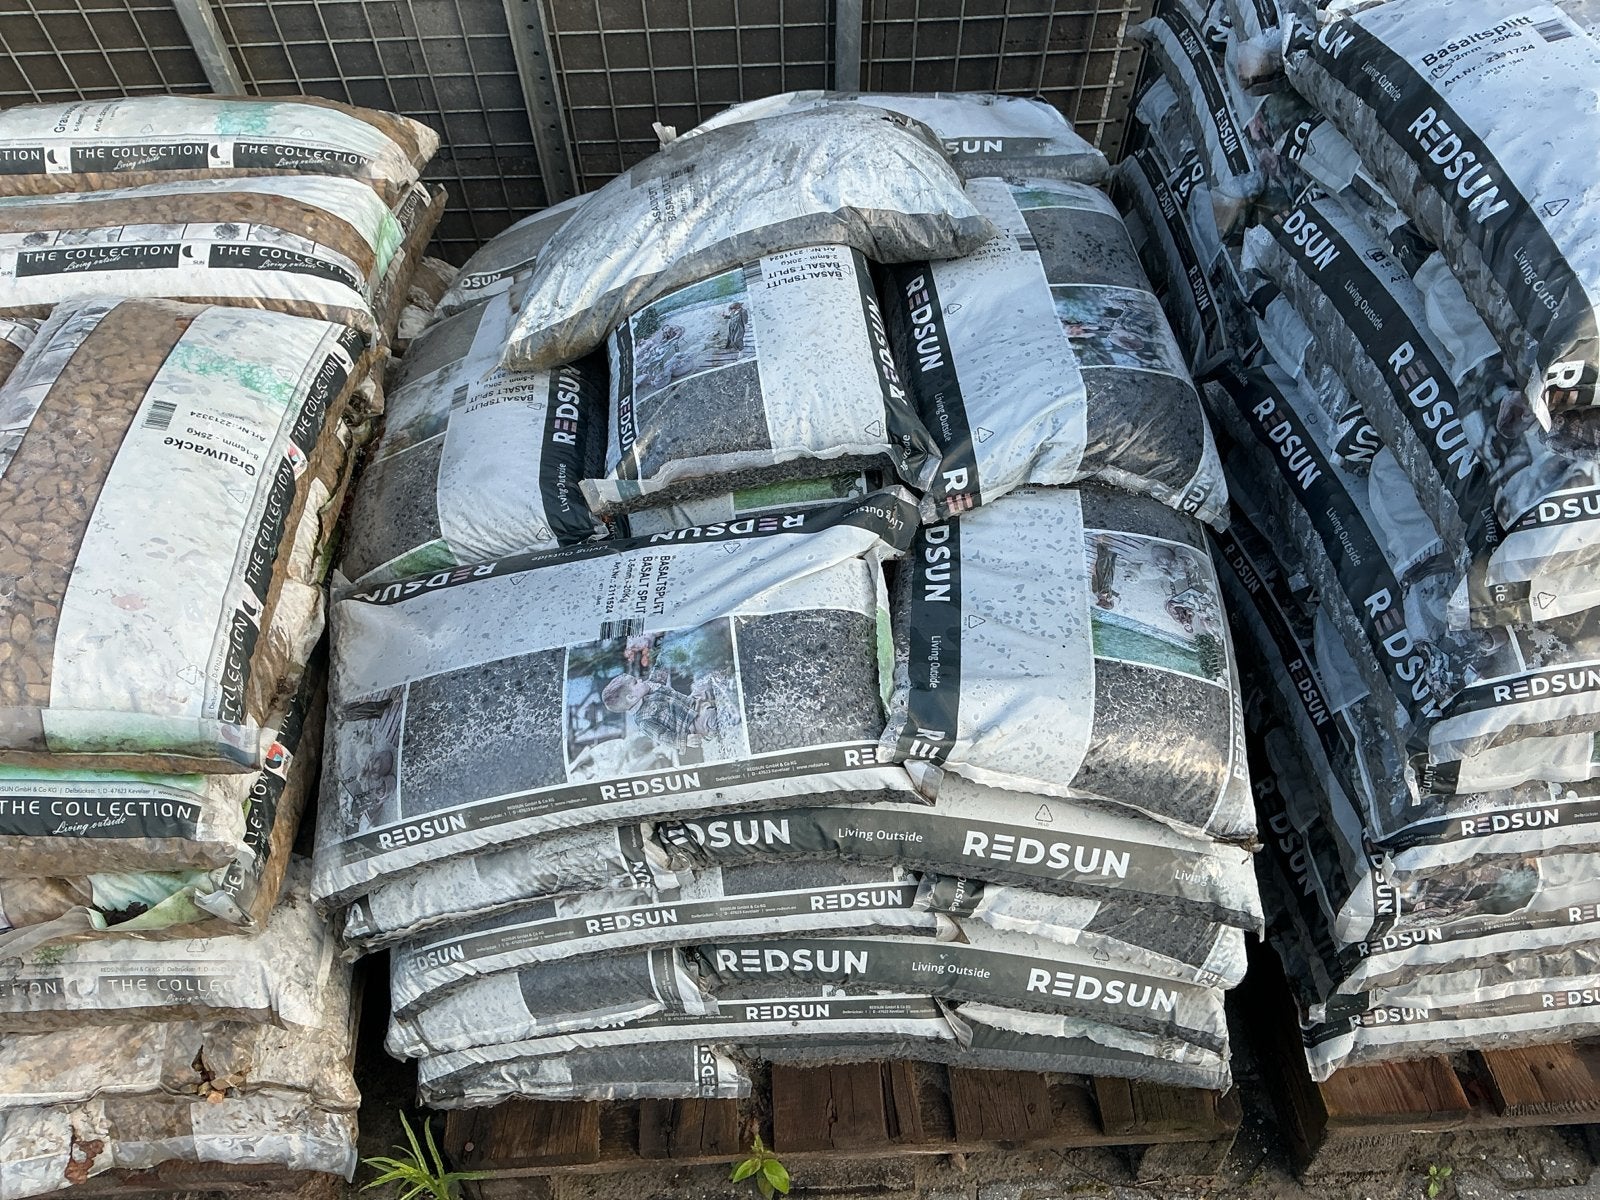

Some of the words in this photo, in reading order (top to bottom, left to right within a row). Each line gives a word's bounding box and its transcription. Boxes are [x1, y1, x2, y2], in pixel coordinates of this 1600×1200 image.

[1178, 28, 1202, 59] REDSUN
[1421, 15, 1534, 67] Basaltsplitt
[1492, 30, 1523, 46] 20Kg
[1378, 74, 1402, 102] Outside
[1214, 107, 1239, 155] REDSUN
[0, 150, 40, 160] TION
[76, 149, 105, 159] THE
[111, 145, 204, 158] COLLECTION
[240, 144, 268, 155] THE
[274, 146, 369, 165] COLLECTION
[945, 139, 1003, 155] SUN
[114, 158, 136, 171] Living
[274, 157, 299, 168] Living
[1407, 106, 1510, 225] REDSUN
[1154, 182, 1178, 220] REDSUN
[24, 252, 57, 263] THE
[65, 246, 174, 260] COLLECTION
[217, 245, 256, 256] THE
[1281, 209, 1341, 272] DSUN
[64, 259, 92, 272] Living
[257, 258, 287, 270] Living
[767, 267, 798, 280] SPLIT
[799, 261, 841, 272] BASALT
[1513, 246, 1539, 286] Living
[461, 273, 502, 288] DSUN
[766, 270, 843, 289] BASALTSPLITT
[1188, 264, 1211, 311] REDSUN
[1343, 279, 1363, 308] Living
[1359, 296, 1384, 331] Outside
[341, 327, 357, 348] THE
[905, 274, 944, 372] REDSUN
[867, 295, 908, 406] REDSUN
[294, 416, 312, 441] THE
[305, 358, 338, 417] COLLECTION
[464, 394, 534, 414] BASALTSPLITT
[469, 389, 495, 404] SPLIT
[498, 384, 535, 395] BASALT
[553, 363, 582, 446] REDSUN
[934, 392, 946, 415] Living
[620, 394, 638, 451] REDSU
[1387, 341, 1481, 482] REDSUN
[186, 427, 213, 440] 25Kg
[939, 413, 953, 443] Outside
[163, 435, 256, 477] Grauwacke
[222, 438, 259, 461] 8-16mm
[1252, 396, 1323, 491] REDSUN
[557, 487, 570, 513] Living
[1183, 472, 1210, 513] SUN
[247, 553, 264, 584] THE
[259, 463, 292, 551] COLLECTION
[650, 514, 805, 543] REDSUN
[1326, 506, 1343, 535] Living
[1339, 531, 1362, 567] Outside
[1480, 505, 1499, 544] Living
[638, 556, 653, 588] BASALT
[924, 524, 951, 603] DSUN
[1224, 543, 1261, 595] REDSUN
[352, 561, 499, 602] REDSUN
[652, 555, 671, 615] BASALTSPLITT
[605, 584, 617, 614] 2311524
[634, 589, 649, 614] SPLIT
[927, 634, 941, 662] Living
[929, 660, 942, 690] Outside
[1289, 658, 1330, 727] REDSUN
[1233, 689, 1247, 781] REDSUN
[601, 771, 701, 804] REDSUN
[1419, 763, 1437, 796] Living
[0, 801, 40, 815] THE
[51, 801, 192, 819] COLLECTION
[52, 820, 89, 836] Living
[91, 812, 127, 829] outside
[1460, 808, 1560, 836] REDSUN
[378, 812, 467, 850] REDSUN
[838, 827, 874, 842] Living
[876, 829, 924, 843] Outside
[962, 829, 1131, 879] REDSUN
[810, 889, 903, 911] REDSUN
[585, 908, 679, 934] REDSUN
[1357, 927, 1443, 958] REDSUN
[0, 982, 57, 997] TION
[108, 979, 147, 991] THE
[157, 978, 234, 992] COLLEC
[717, 948, 868, 975] REDSUN
[911, 960, 945, 975] Living
[947, 963, 991, 979] Outside
[1026, 967, 1179, 1014] REDSUN
[745, 1004, 830, 1020] REDSUN
[1348, 1007, 1429, 1030] REDSUN
[701, 1046, 718, 1097] REDS
